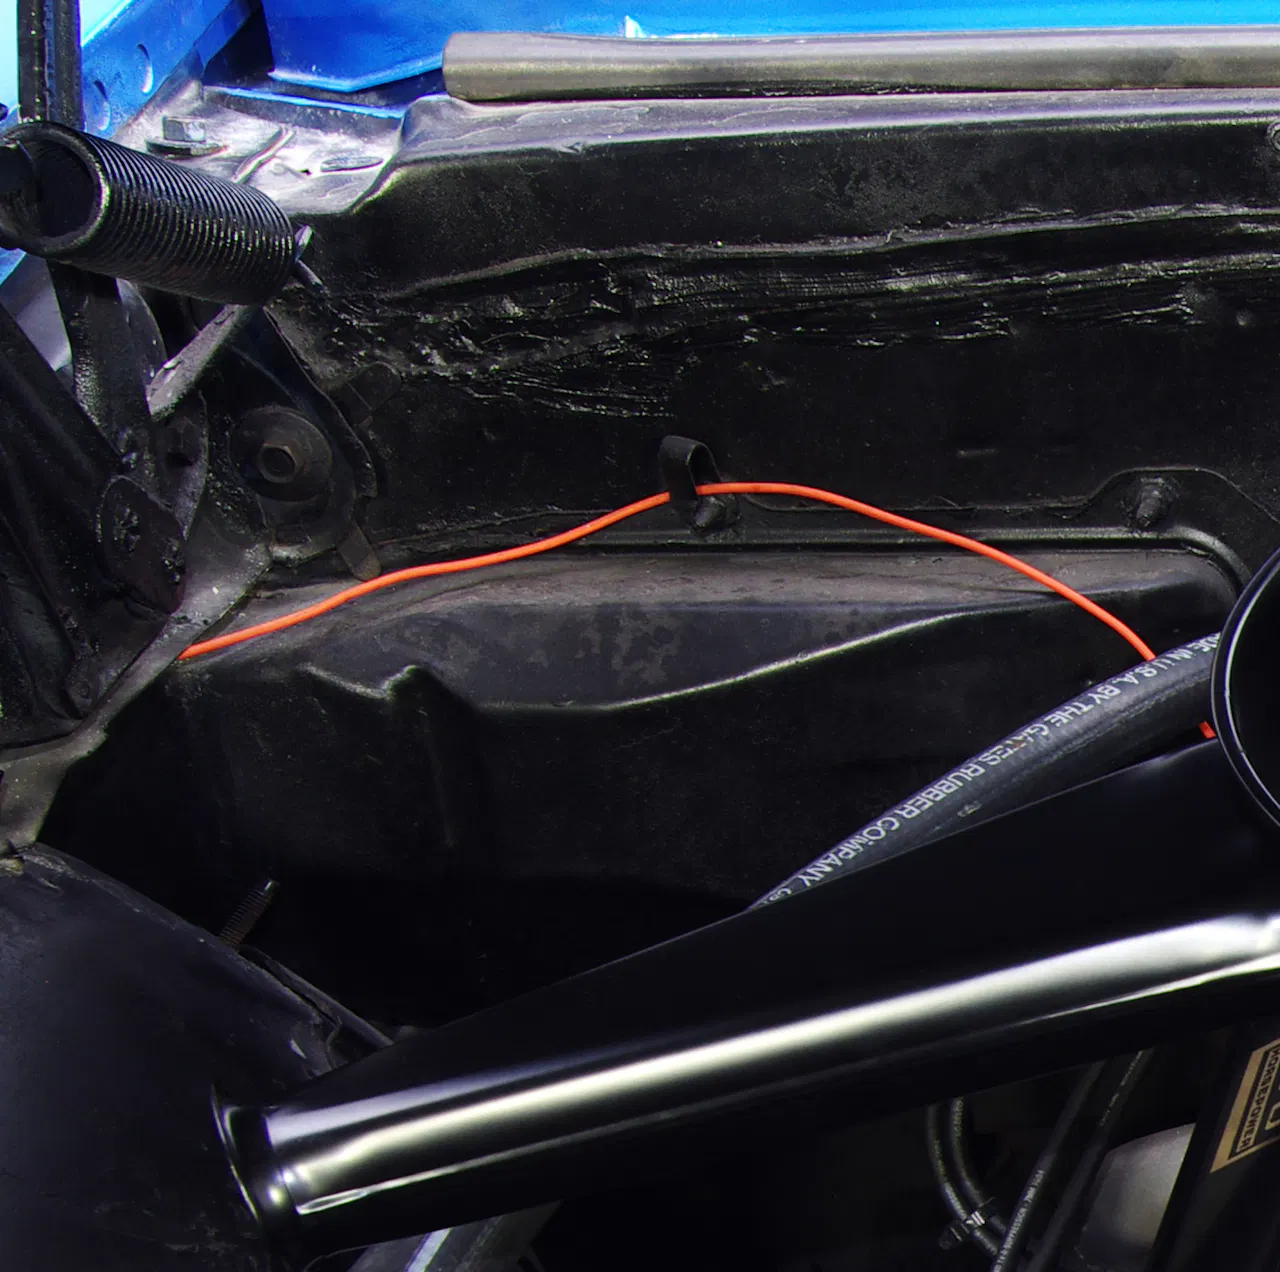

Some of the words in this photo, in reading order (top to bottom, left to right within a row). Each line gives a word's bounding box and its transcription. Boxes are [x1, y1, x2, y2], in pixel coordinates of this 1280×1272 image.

[1043, 700, 1094, 728] THE
[1089, 684, 1122, 705] BY
[979, 723, 1051, 767] GATES
[892, 763, 986, 820] RUBBER
[797, 816, 901, 888] COMPANY
